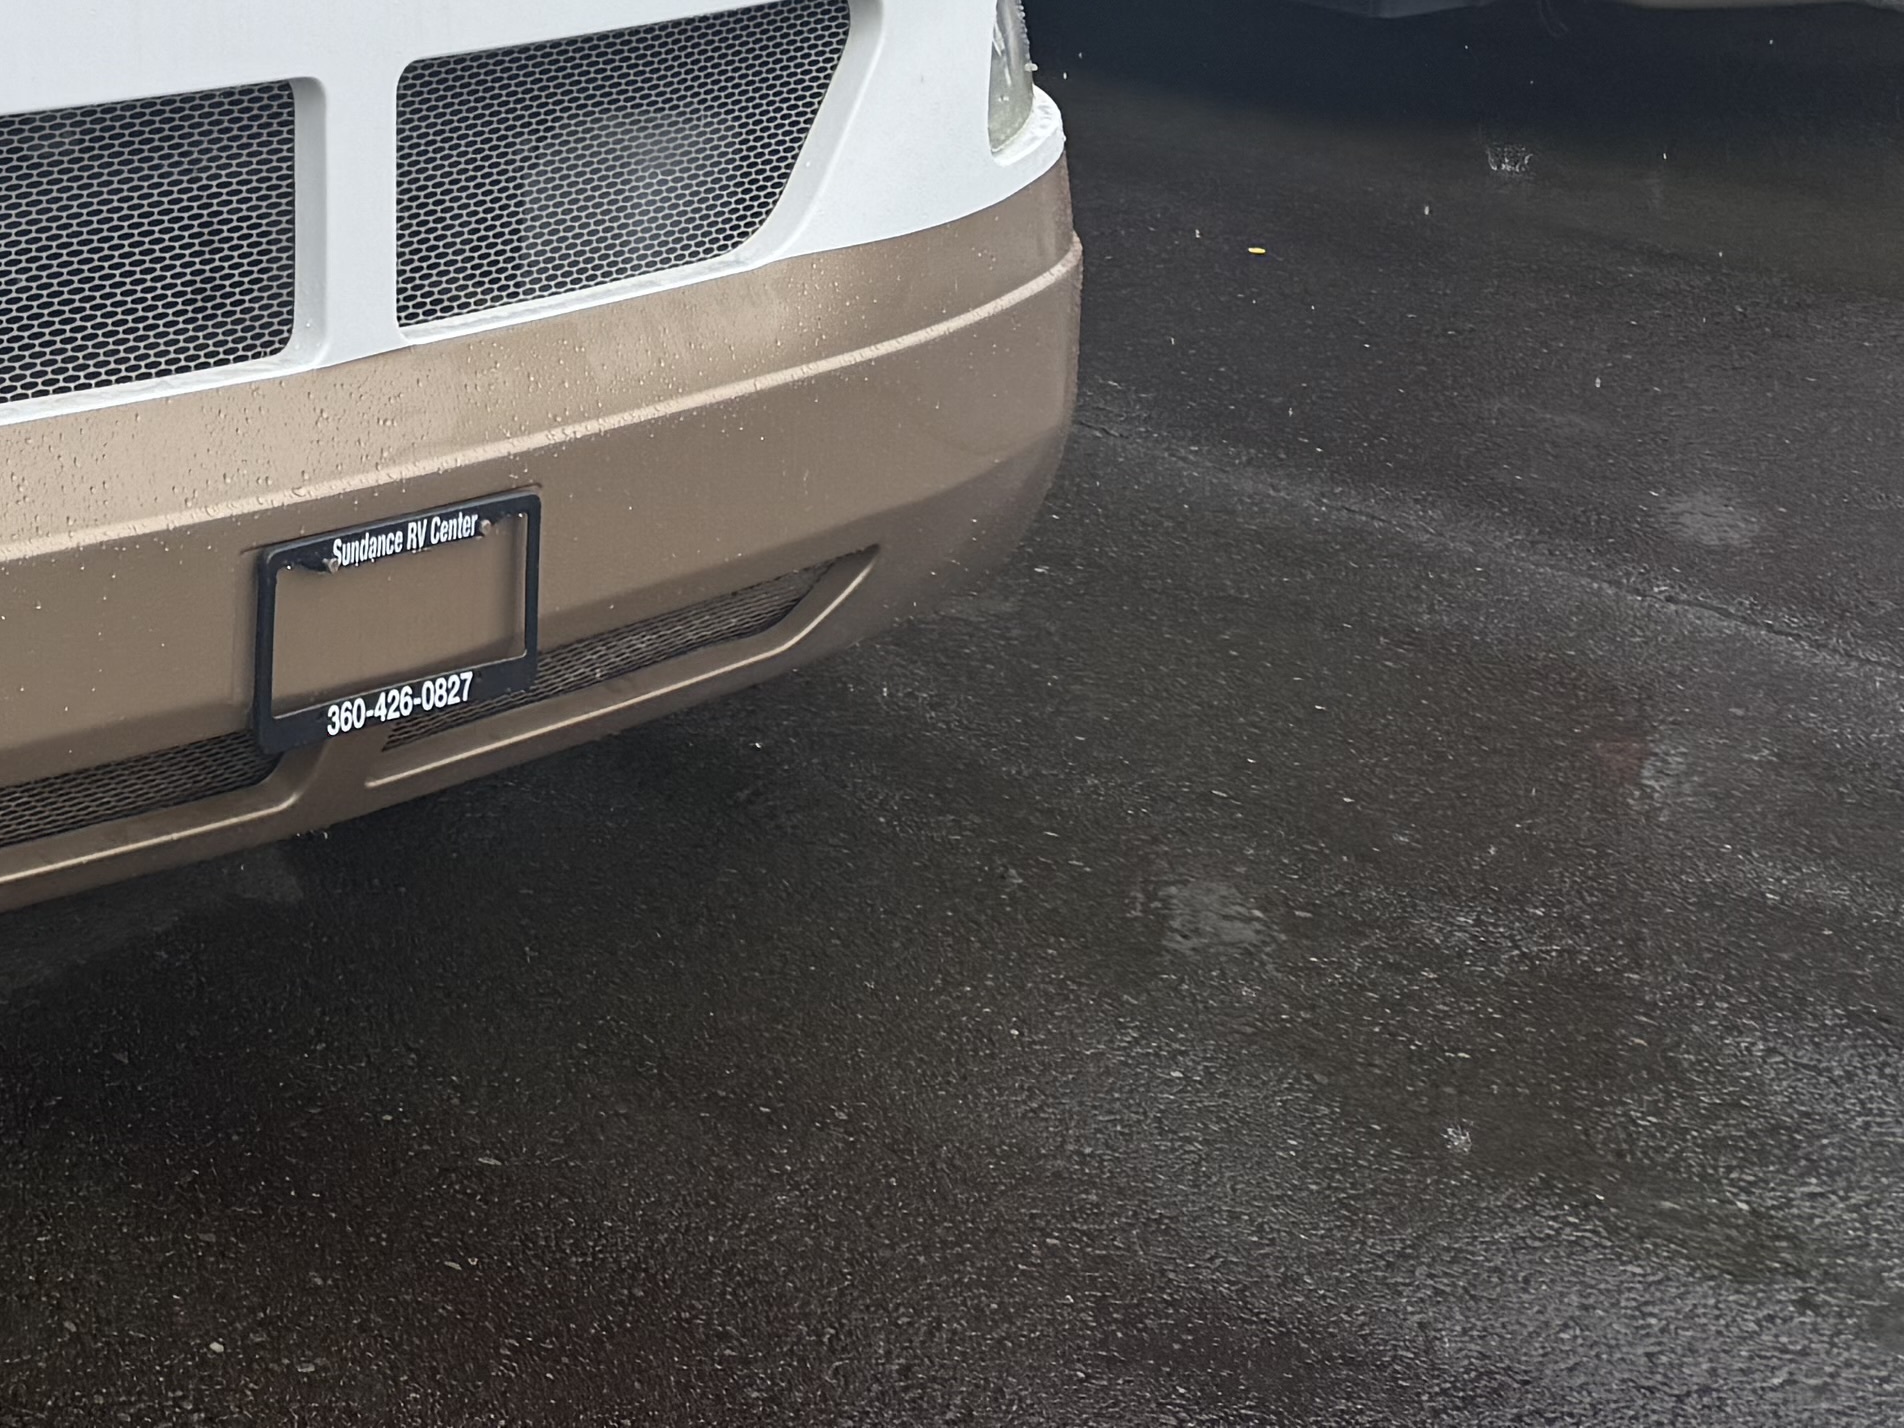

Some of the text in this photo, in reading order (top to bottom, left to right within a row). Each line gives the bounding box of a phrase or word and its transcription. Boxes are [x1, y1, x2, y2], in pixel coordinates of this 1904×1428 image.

[333, 511, 479, 567] Sundance RV Center
[326, 670, 474, 737] 360-426-0827
